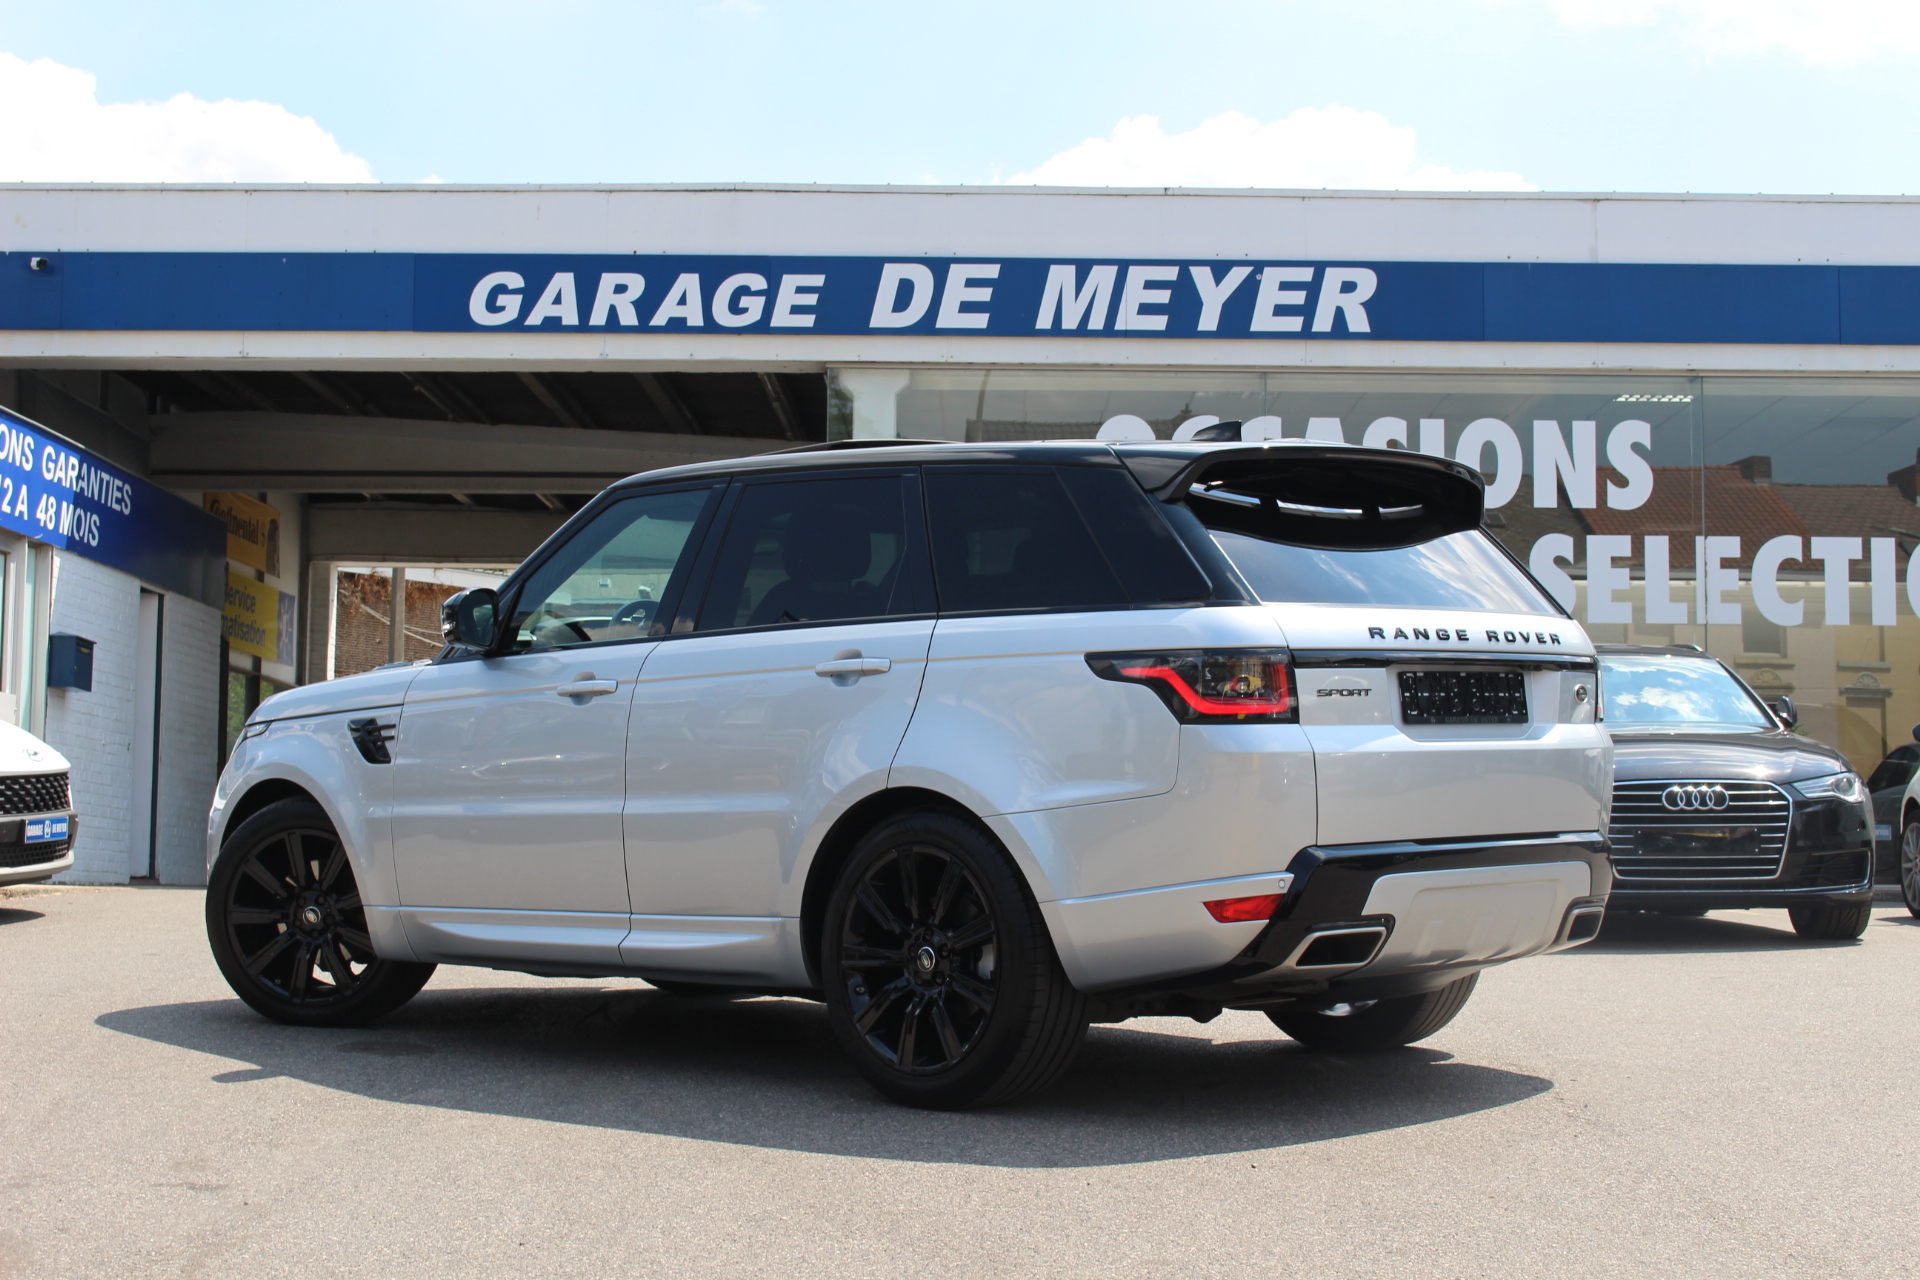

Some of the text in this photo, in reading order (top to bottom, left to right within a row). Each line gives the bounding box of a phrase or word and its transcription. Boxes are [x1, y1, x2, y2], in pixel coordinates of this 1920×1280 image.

[467, 261, 1379, 334] GARAGE DE MEYER
[42, 445, 132, 515] GARANTIES
[14, 484, 28, 521] A
[36, 493, 57, 531] 48
[59, 501, 100, 547] MOIS
[225, 585, 257, 614] ervice
[1529, 532, 1920, 627] SELECTI
[1368, 626, 1562, 645] RANGE ROVER
[1316, 688, 1372, 698] SPORT
[27, 825, 44, 837] GARAGE
